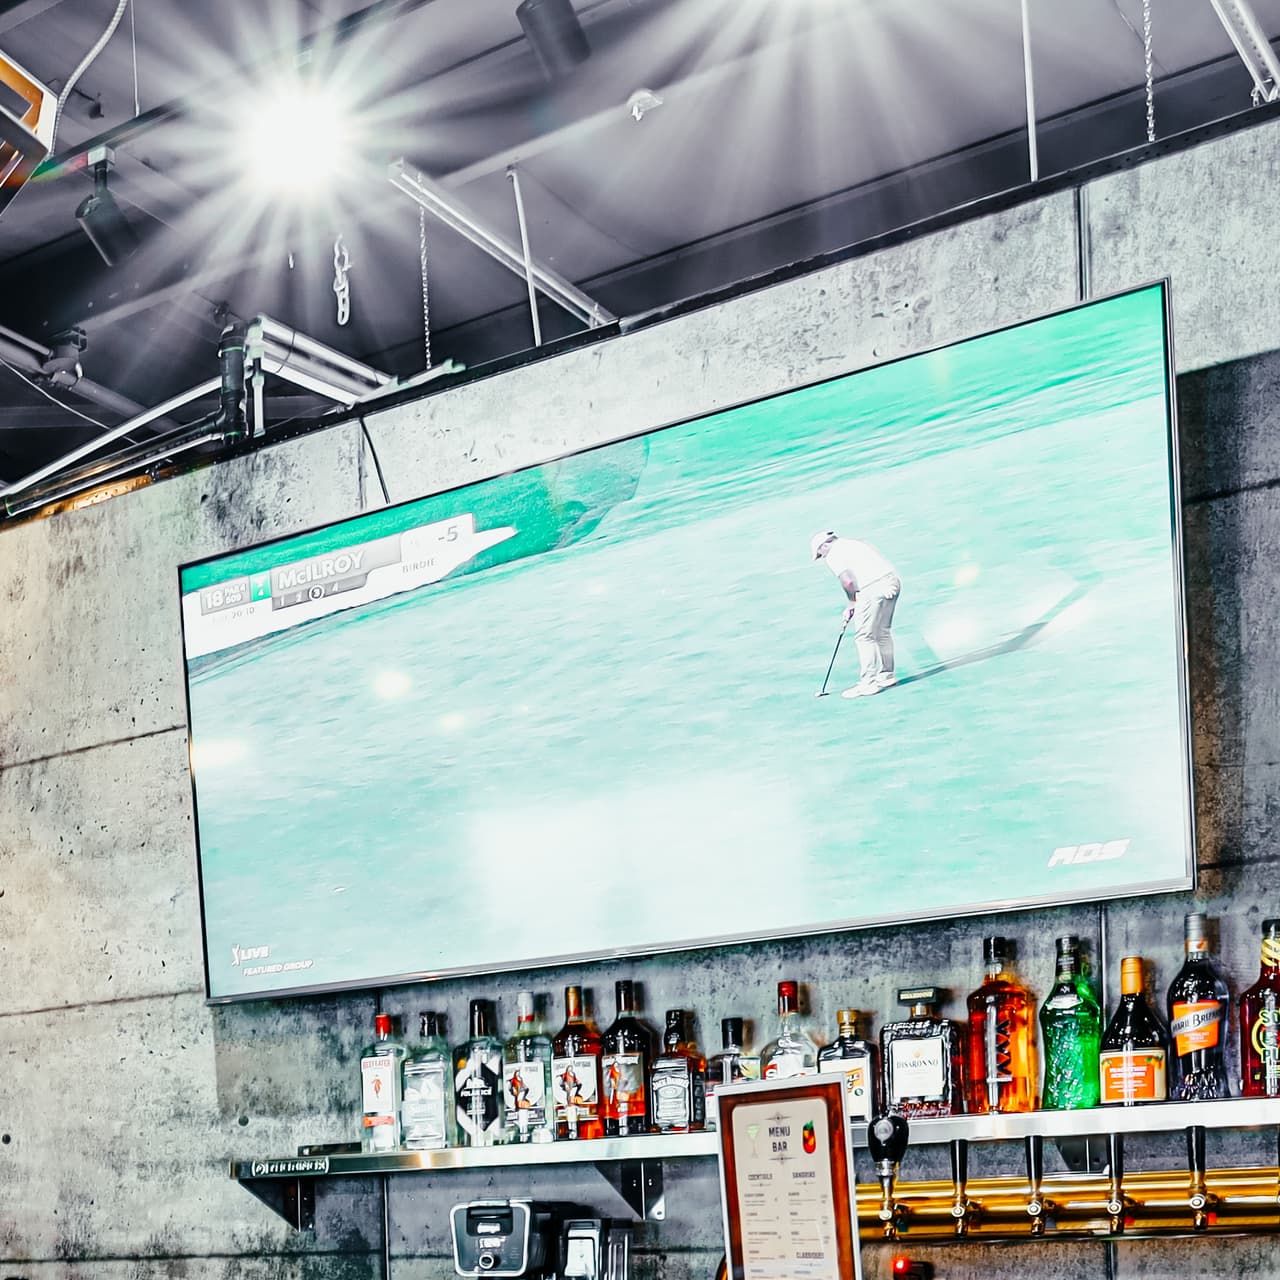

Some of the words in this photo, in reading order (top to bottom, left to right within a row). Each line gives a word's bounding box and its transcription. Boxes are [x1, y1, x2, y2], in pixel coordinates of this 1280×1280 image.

[279, 551, 363, 590] McILROY
[205, 590, 223, 610] 18
[897, 1060, 939, 1069] DISARONNO
[769, 1126, 791, 1137] MENU
[772, 1141, 788, 1152] BAR
